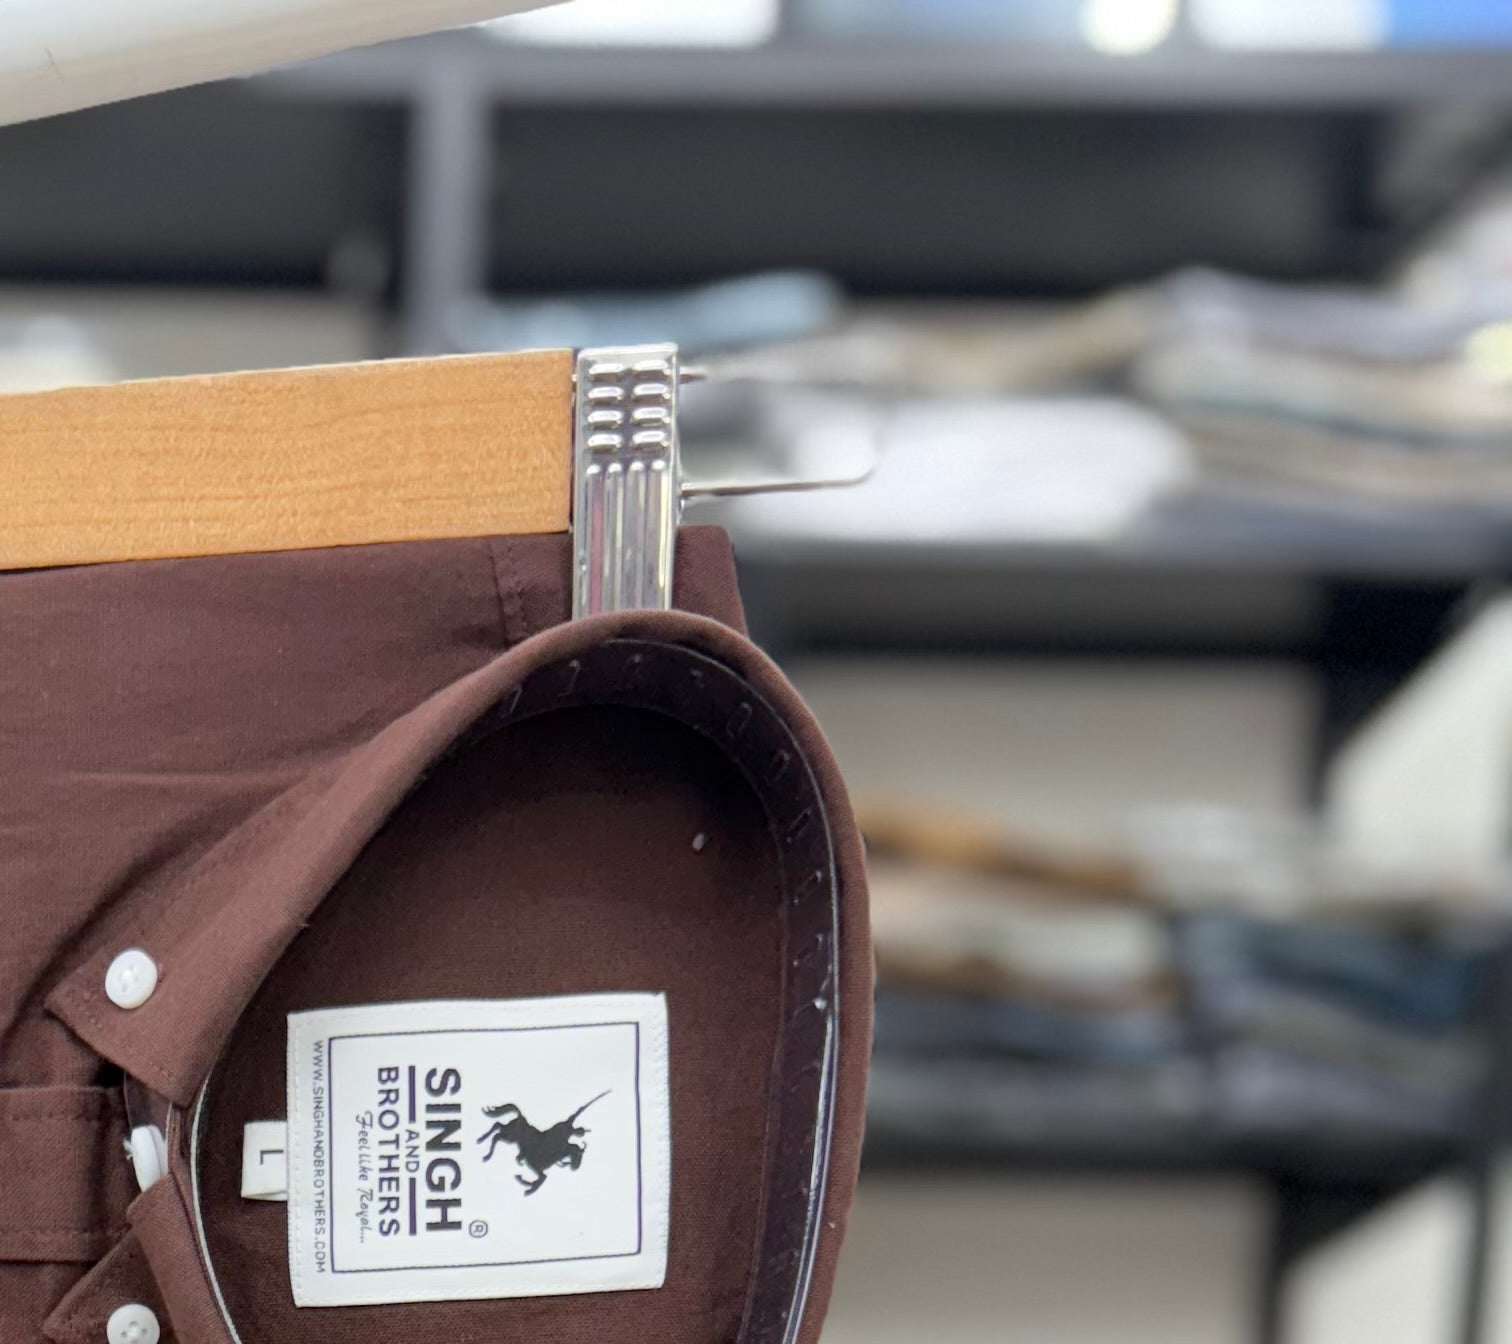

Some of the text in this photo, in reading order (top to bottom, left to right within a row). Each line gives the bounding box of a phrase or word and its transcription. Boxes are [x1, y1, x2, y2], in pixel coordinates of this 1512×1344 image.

[356, 1110, 373, 1150] Feel
[378, 1066, 401, 1237] BROTHERS
[405, 1129, 420, 1173] AND
[425, 1067, 462, 1231] SINGH
[259, 1149, 284, 1165] L
[313, 1040, 326, 1273] WWW.SINGHANDBROTHERS.COM
[358, 1152, 373, 1182] like
